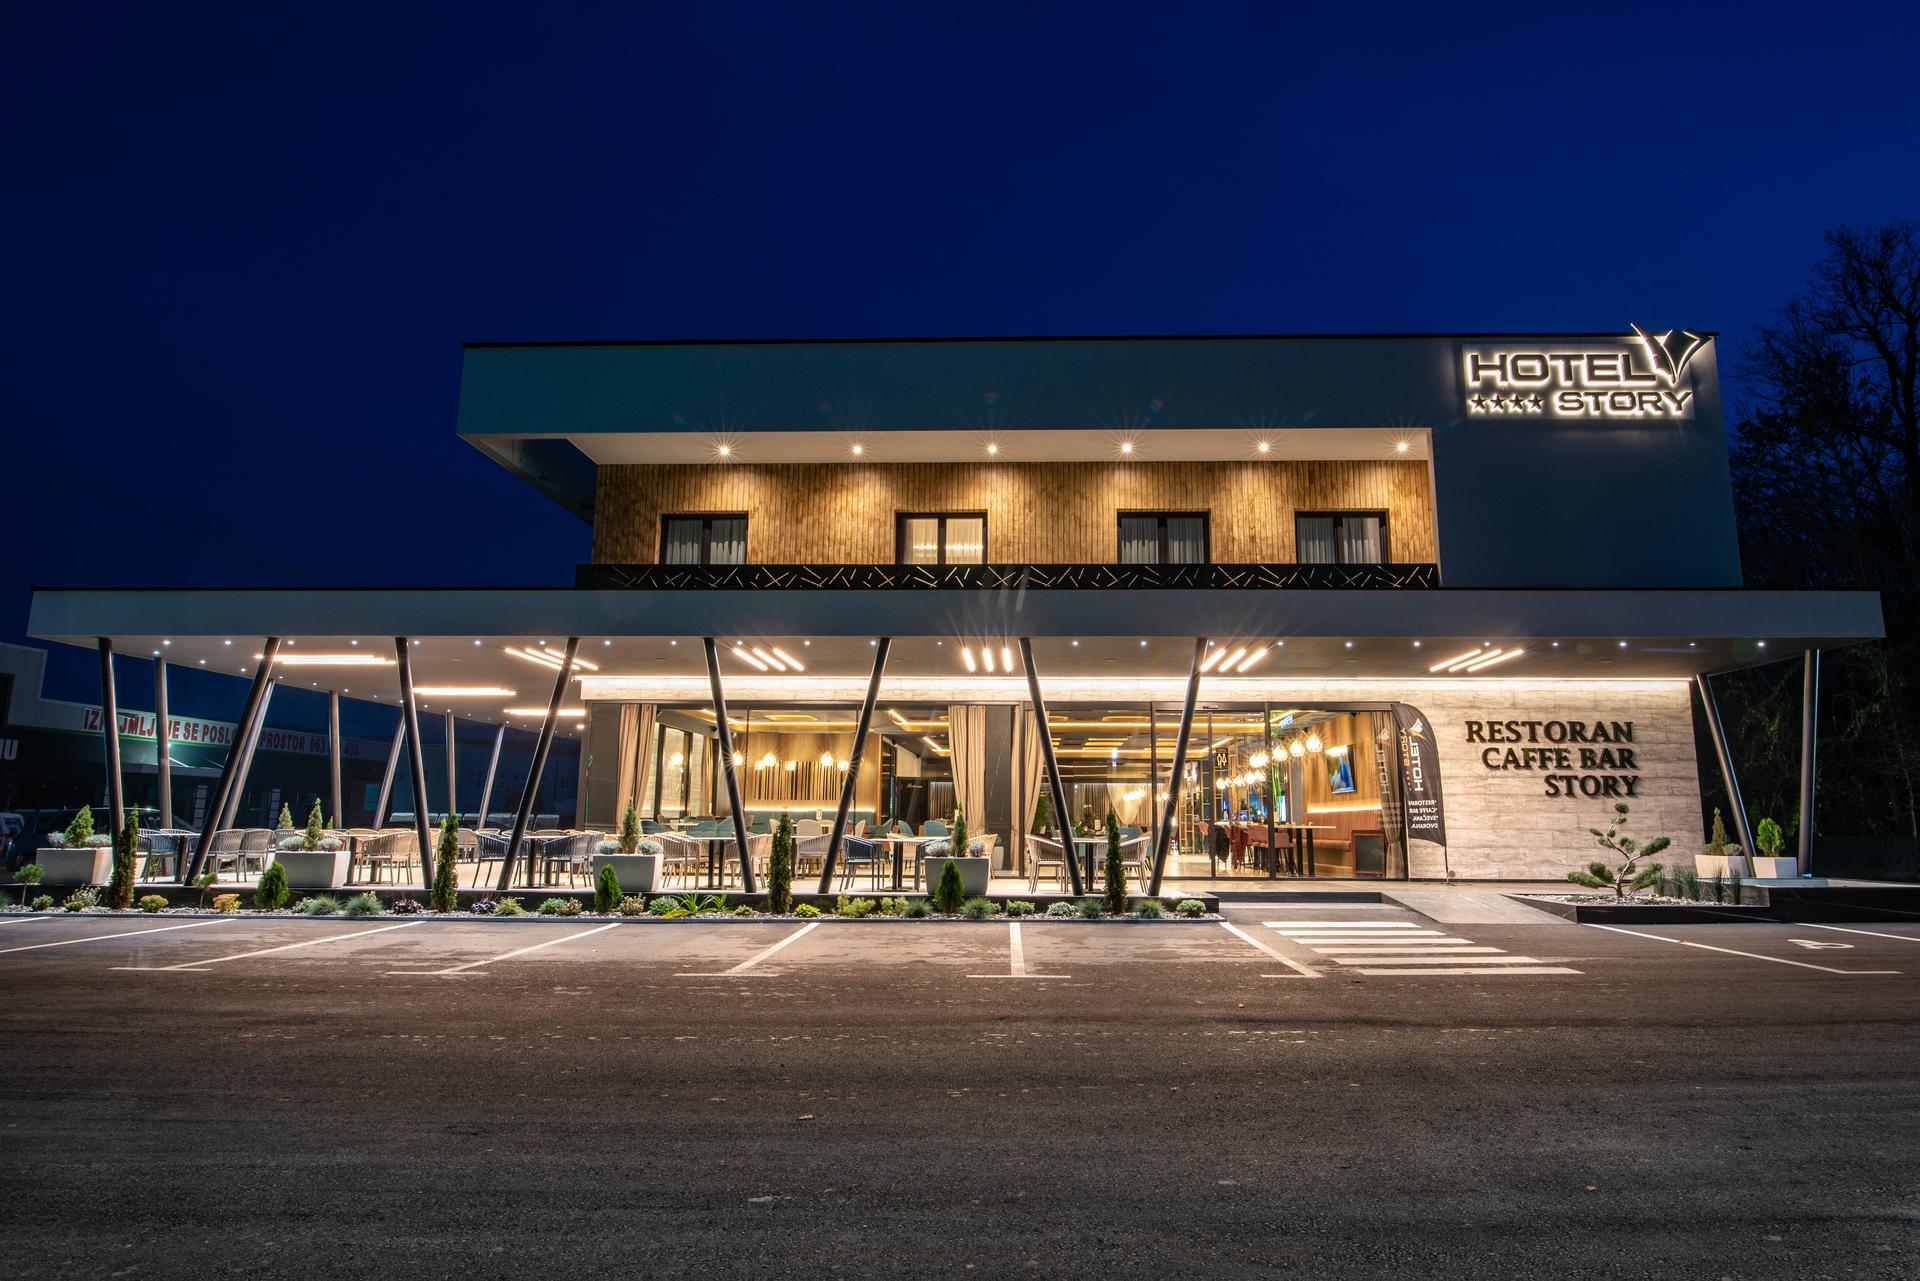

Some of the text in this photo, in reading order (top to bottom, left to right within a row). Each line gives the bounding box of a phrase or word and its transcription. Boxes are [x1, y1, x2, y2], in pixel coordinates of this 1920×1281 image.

[1469, 353, 1657, 385] HOTEL
[1556, 391, 1693, 414] STORY
[183, 721, 199, 741] SE
[260, 730, 304, 752] PROSTOR
[1465, 720, 1634, 743] RESTORAN
[1481, 747, 1638, 769] CAFFE BAR
[1544, 774, 1639, 797] STORY
